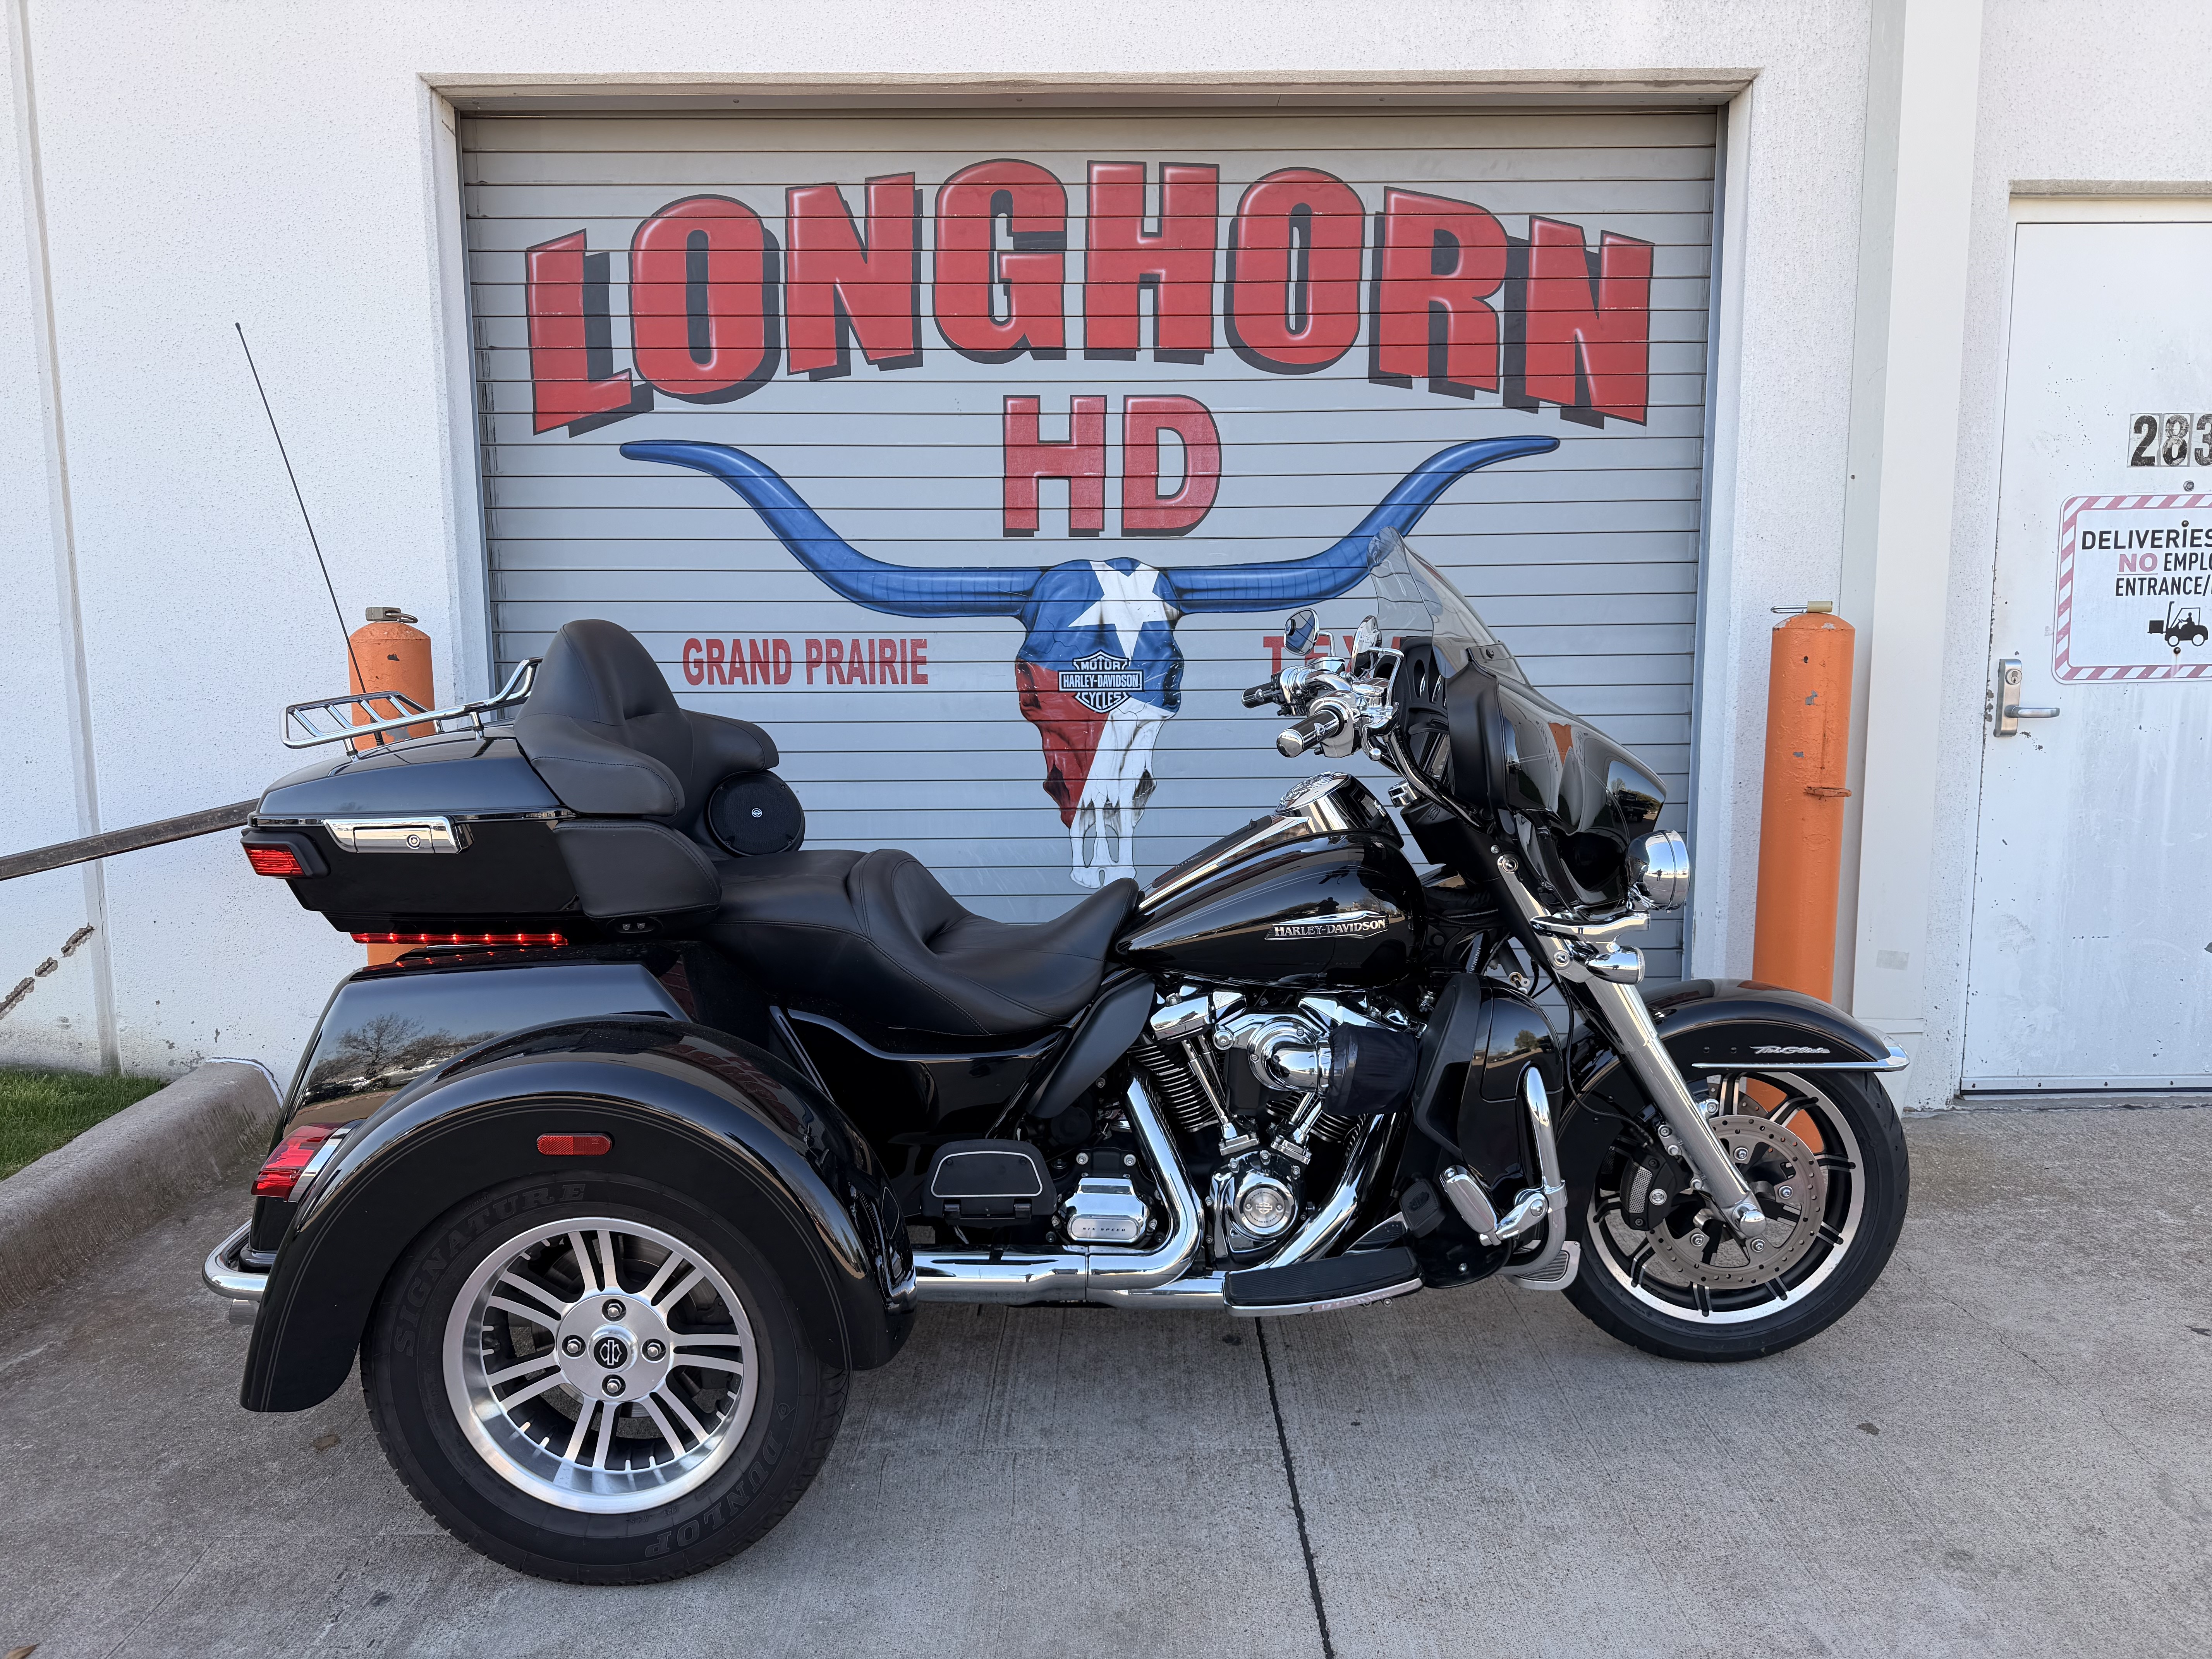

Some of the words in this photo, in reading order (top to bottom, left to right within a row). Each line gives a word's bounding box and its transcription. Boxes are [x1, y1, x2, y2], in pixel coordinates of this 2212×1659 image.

[525, 158, 1654, 436] LONGHORN
[2130, 414, 2212, 466] 283
[1002, 393, 1222, 538] HD
[2082, 528, 2212, 550] DELIVERIES
[2119, 553, 2158, 572] NO
[2116, 574, 2212, 596] ENTRANCE/
[683, 638, 792, 685] GRAND
[805, 639, 928, 685] PRAIRIE
[1081, 657, 1120, 670] MOTOR
[1063, 674, 1139, 687] HARLEY-DAVIDSON
[1082, 692, 1121, 709] CYCLES
[1274, 919, 1386, 936] HARLEY-DAVIDSON
[394, 1184, 586, 1357] SIGNATURE
[645, 1430, 783, 1558] DUNLOP
